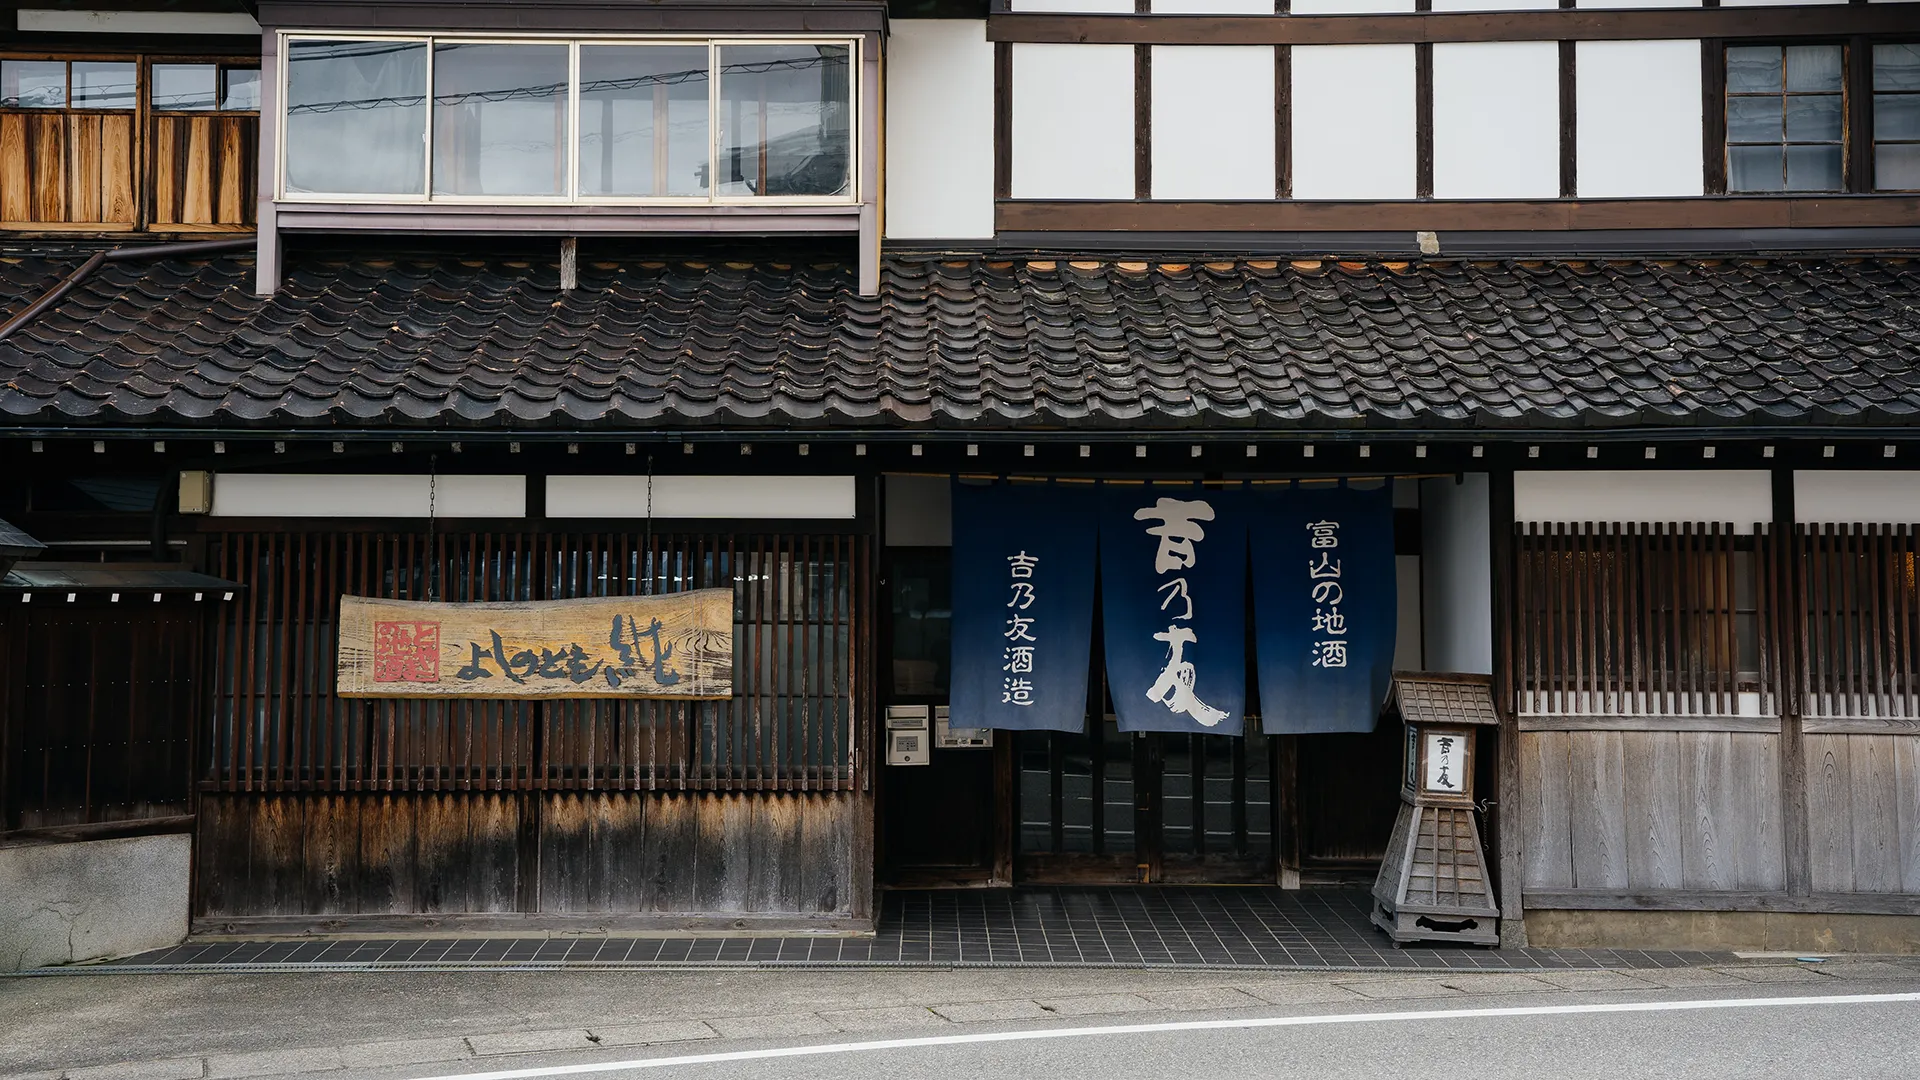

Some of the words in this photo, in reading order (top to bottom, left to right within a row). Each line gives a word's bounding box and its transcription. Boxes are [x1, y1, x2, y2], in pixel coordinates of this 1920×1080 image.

[1002, 551, 1038, 705] 吉乃友酒造
[1134, 499, 1230, 726] 吉乃友
[1307, 521, 1347, 667] 富山の地酒
[1437, 737, 1455, 788] 吉乃友
